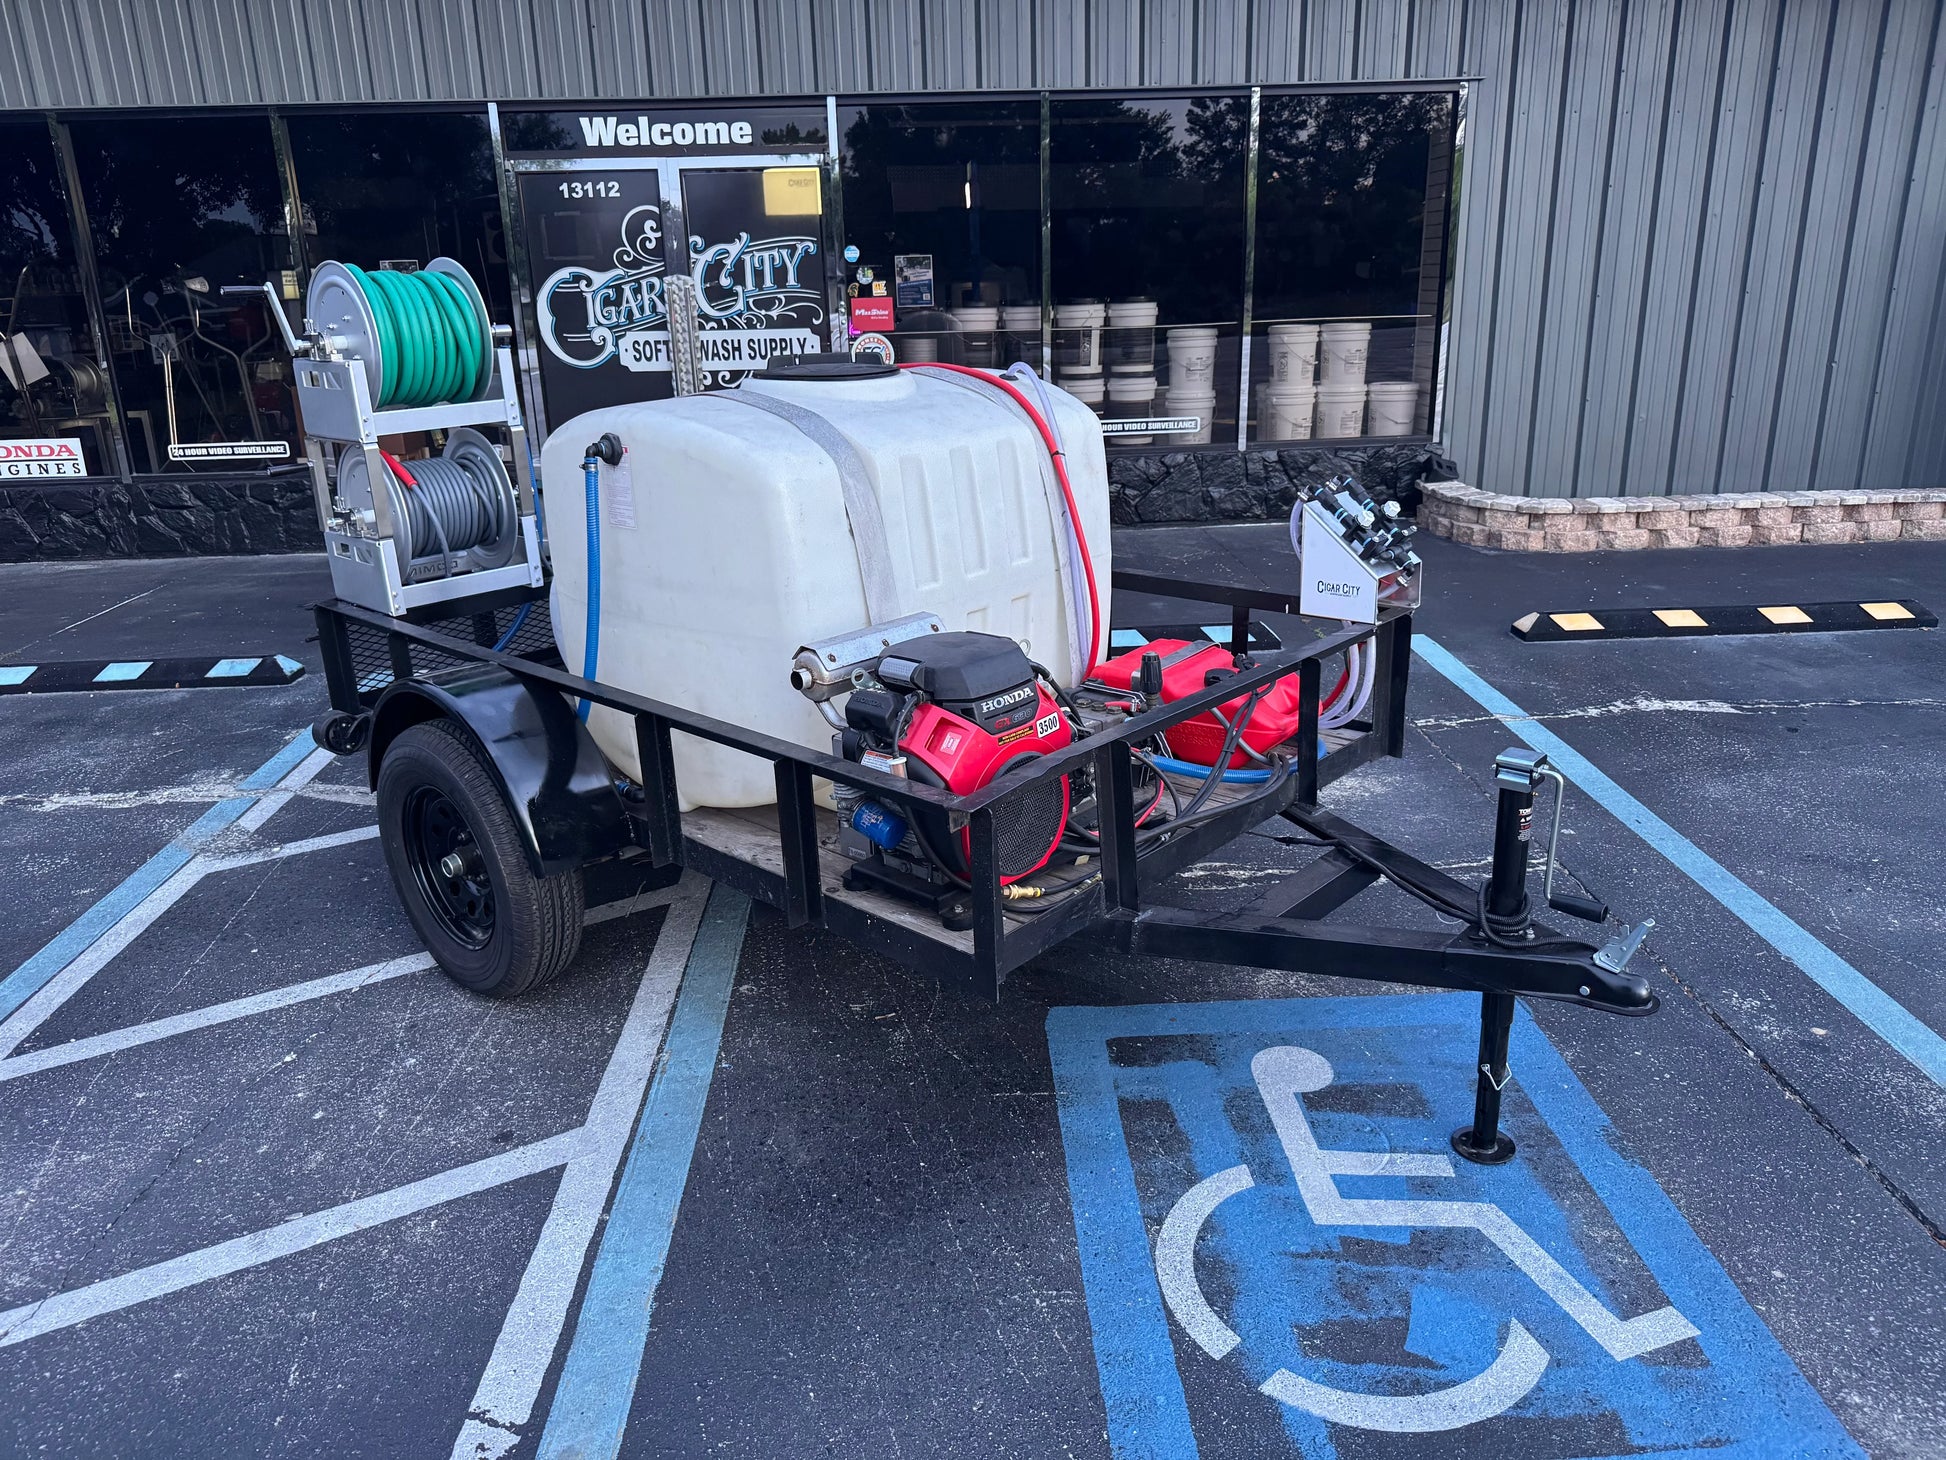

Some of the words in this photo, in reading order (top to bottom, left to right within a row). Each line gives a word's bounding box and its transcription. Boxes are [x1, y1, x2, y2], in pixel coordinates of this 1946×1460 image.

[579, 116, 753, 147] Welcome
[558, 181, 621, 199] 13112
[537, 266, 666, 369] CIGAR
[693, 231, 817, 318] CITY
[632, 339, 671, 362] SOFT
[747, 337, 807, 361] SUPPLY
[1102, 422, 1123, 431] HOUR
[1123, 422, 1147, 431] VIDEO
[1147, 420, 1197, 430] SURVEILLANCE
[184, 448, 208, 456] HOUR
[208, 446, 233, 455] VIDEO
[233, 445, 286, 454] SURVEILLANCE
[0, 462, 81, 476] GINES
[1317, 580, 1341, 593] CIGAR
[1342, 583, 1361, 596] CITY
[981, 687, 1034, 713] HONDA
[1038, 714, 1058, 735] 3500
